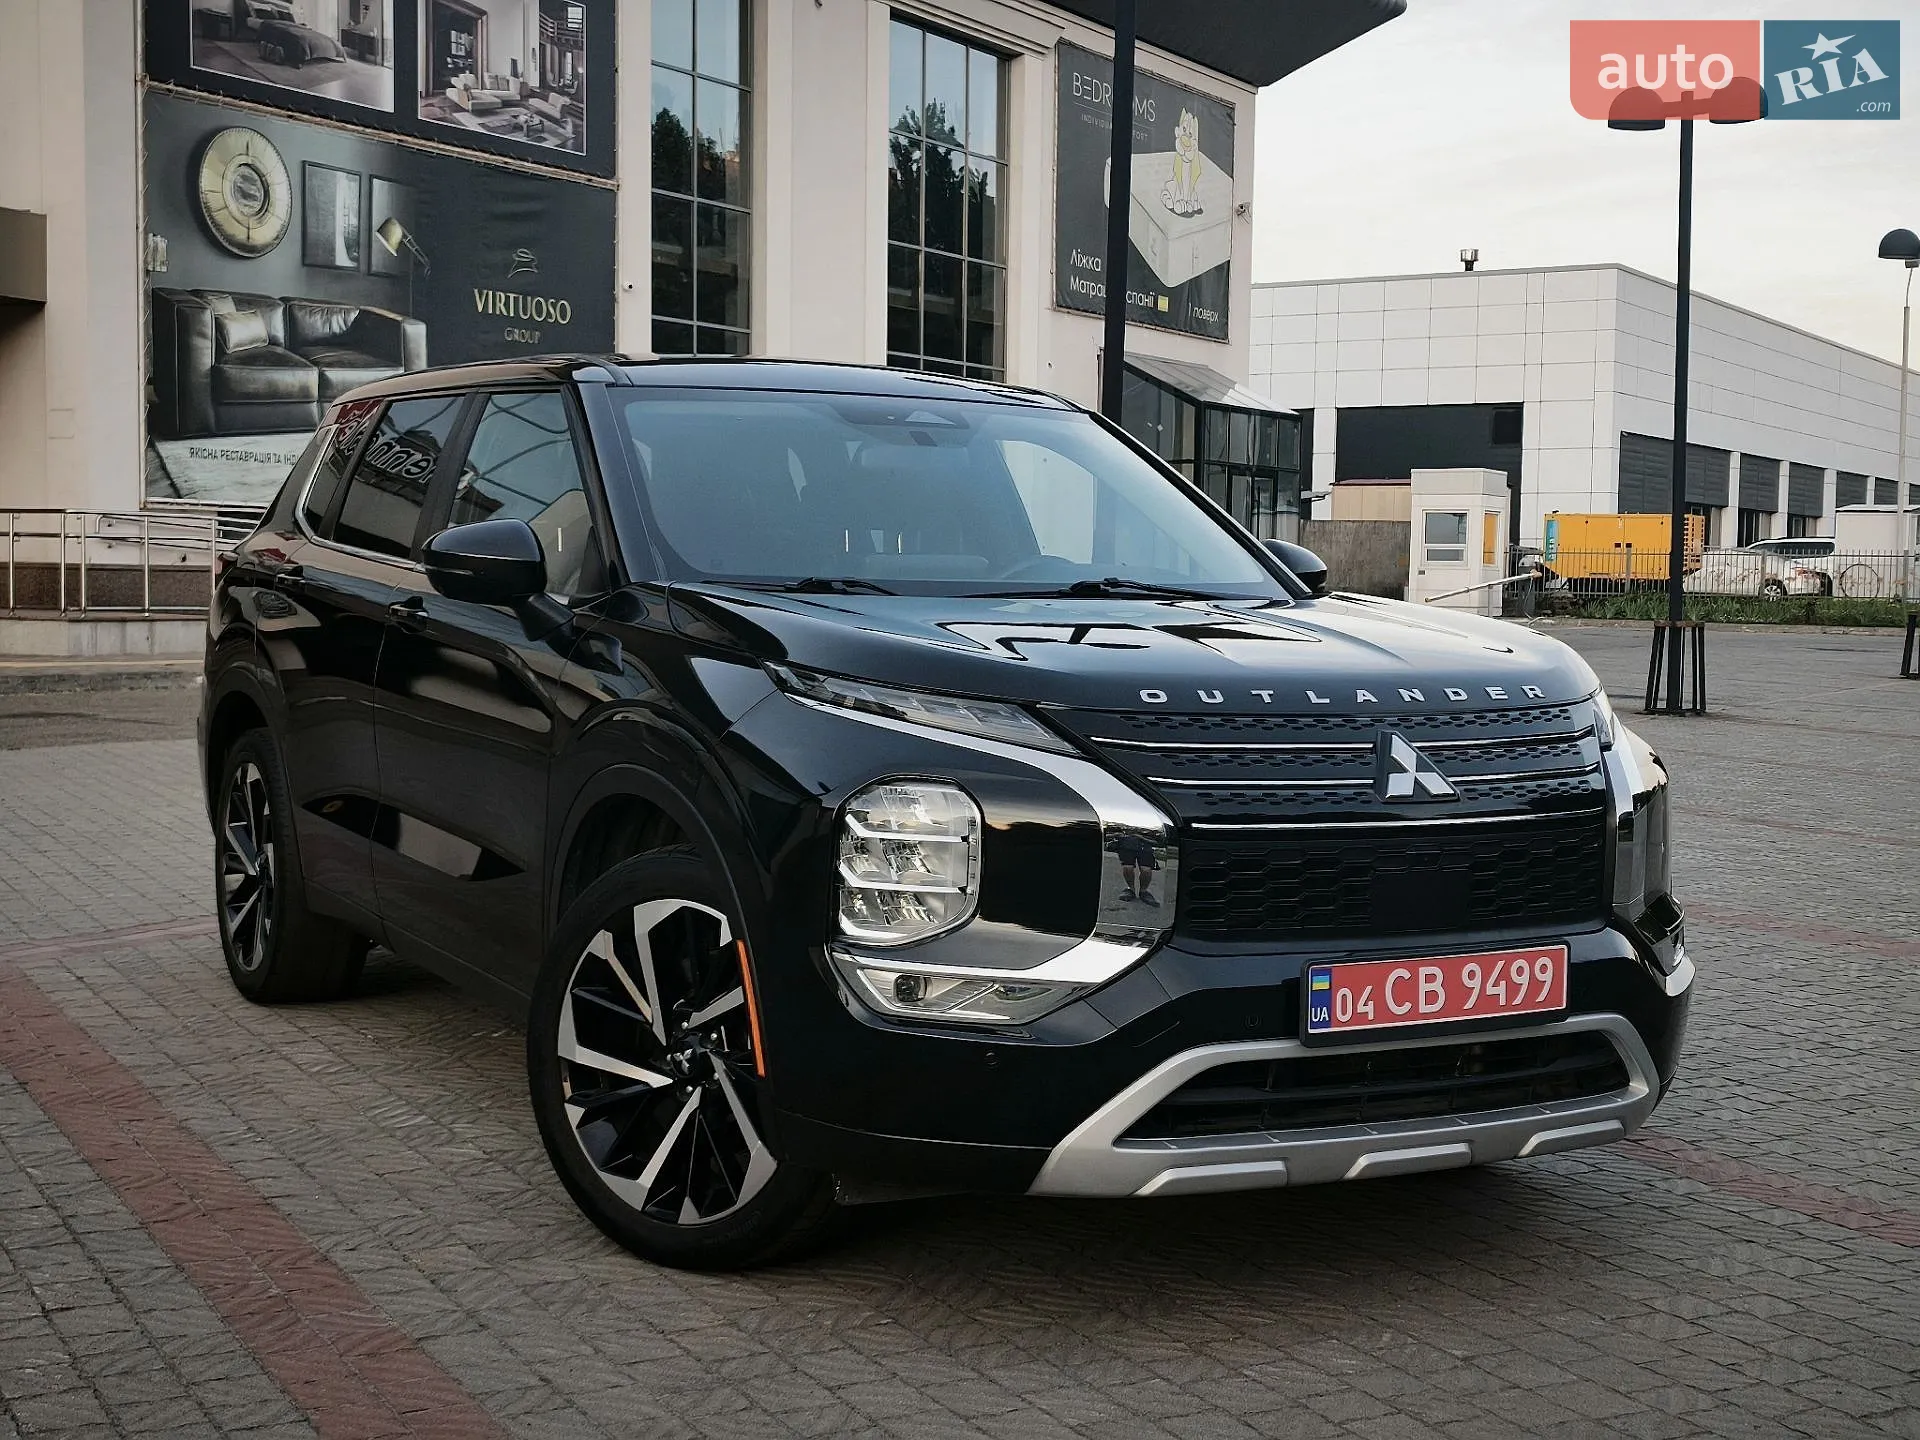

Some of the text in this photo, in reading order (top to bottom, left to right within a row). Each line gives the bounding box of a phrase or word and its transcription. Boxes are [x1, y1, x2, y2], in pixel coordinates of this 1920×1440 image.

[1073, 72, 1156, 122] BEDRMS
[1070, 248, 1101, 272] Ліжка
[473, 288, 571, 324] VIRTUOSO
[1125, 290, 1156, 308] спанії
[1193, 306, 1219, 324] поверх
[504, 327, 541, 344] GROUP
[190, 447, 218, 460] ЯКІСНА
[220, 449, 272, 465] РЕСТАВРАЦІЯ
[1139, 684, 1546, 705] OUTLANDER
[1336, 956, 1554, 1023] 04 CB 9499
[1311, 1006, 1329, 1022] UA
